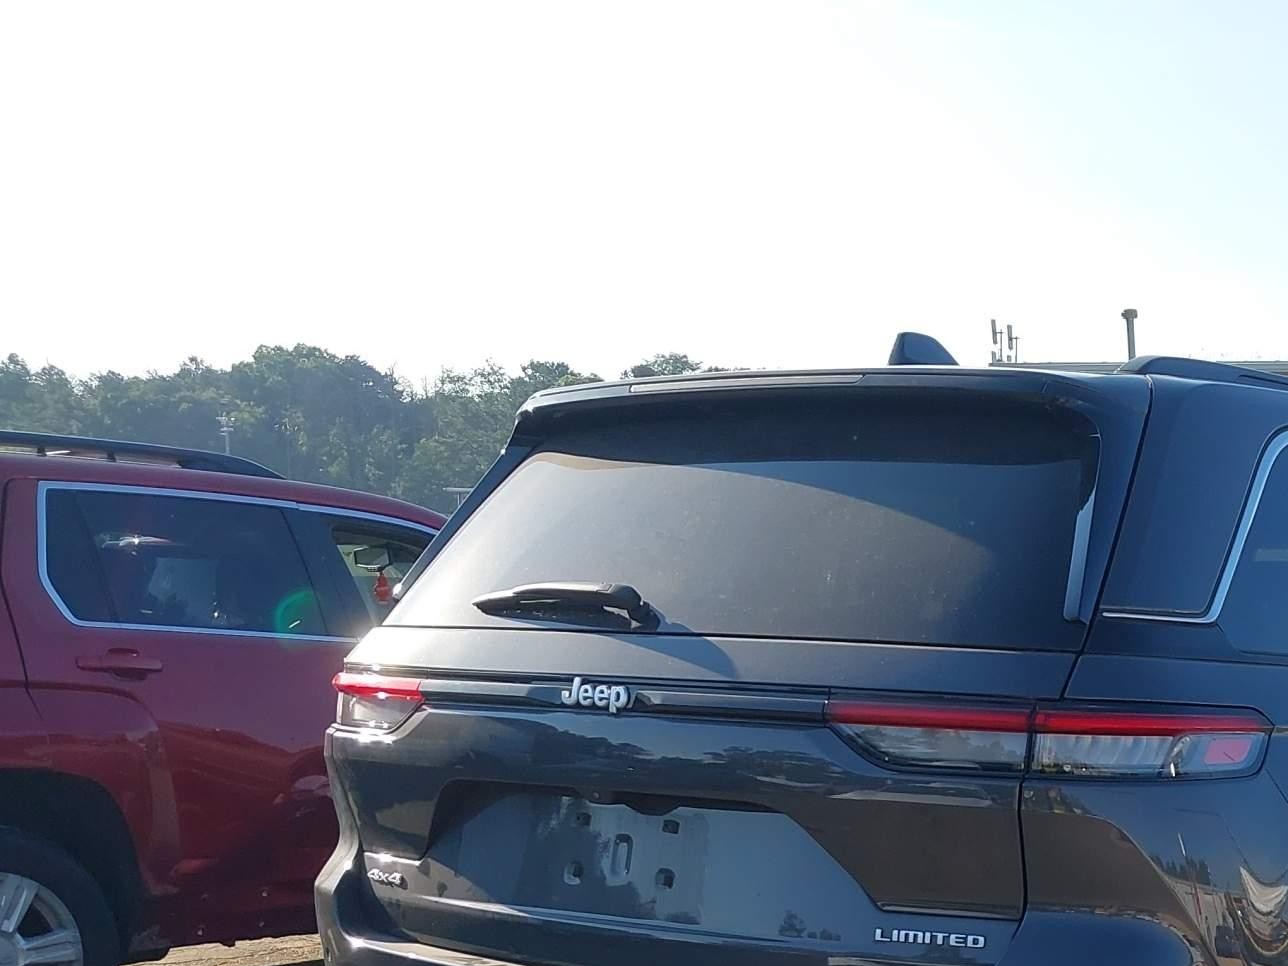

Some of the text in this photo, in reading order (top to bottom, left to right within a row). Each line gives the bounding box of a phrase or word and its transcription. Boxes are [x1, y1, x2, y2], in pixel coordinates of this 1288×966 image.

[561, 676, 628, 714] Jeep
[367, 868, 402, 885] 4x4
[875, 928, 985, 948] LIMITED
